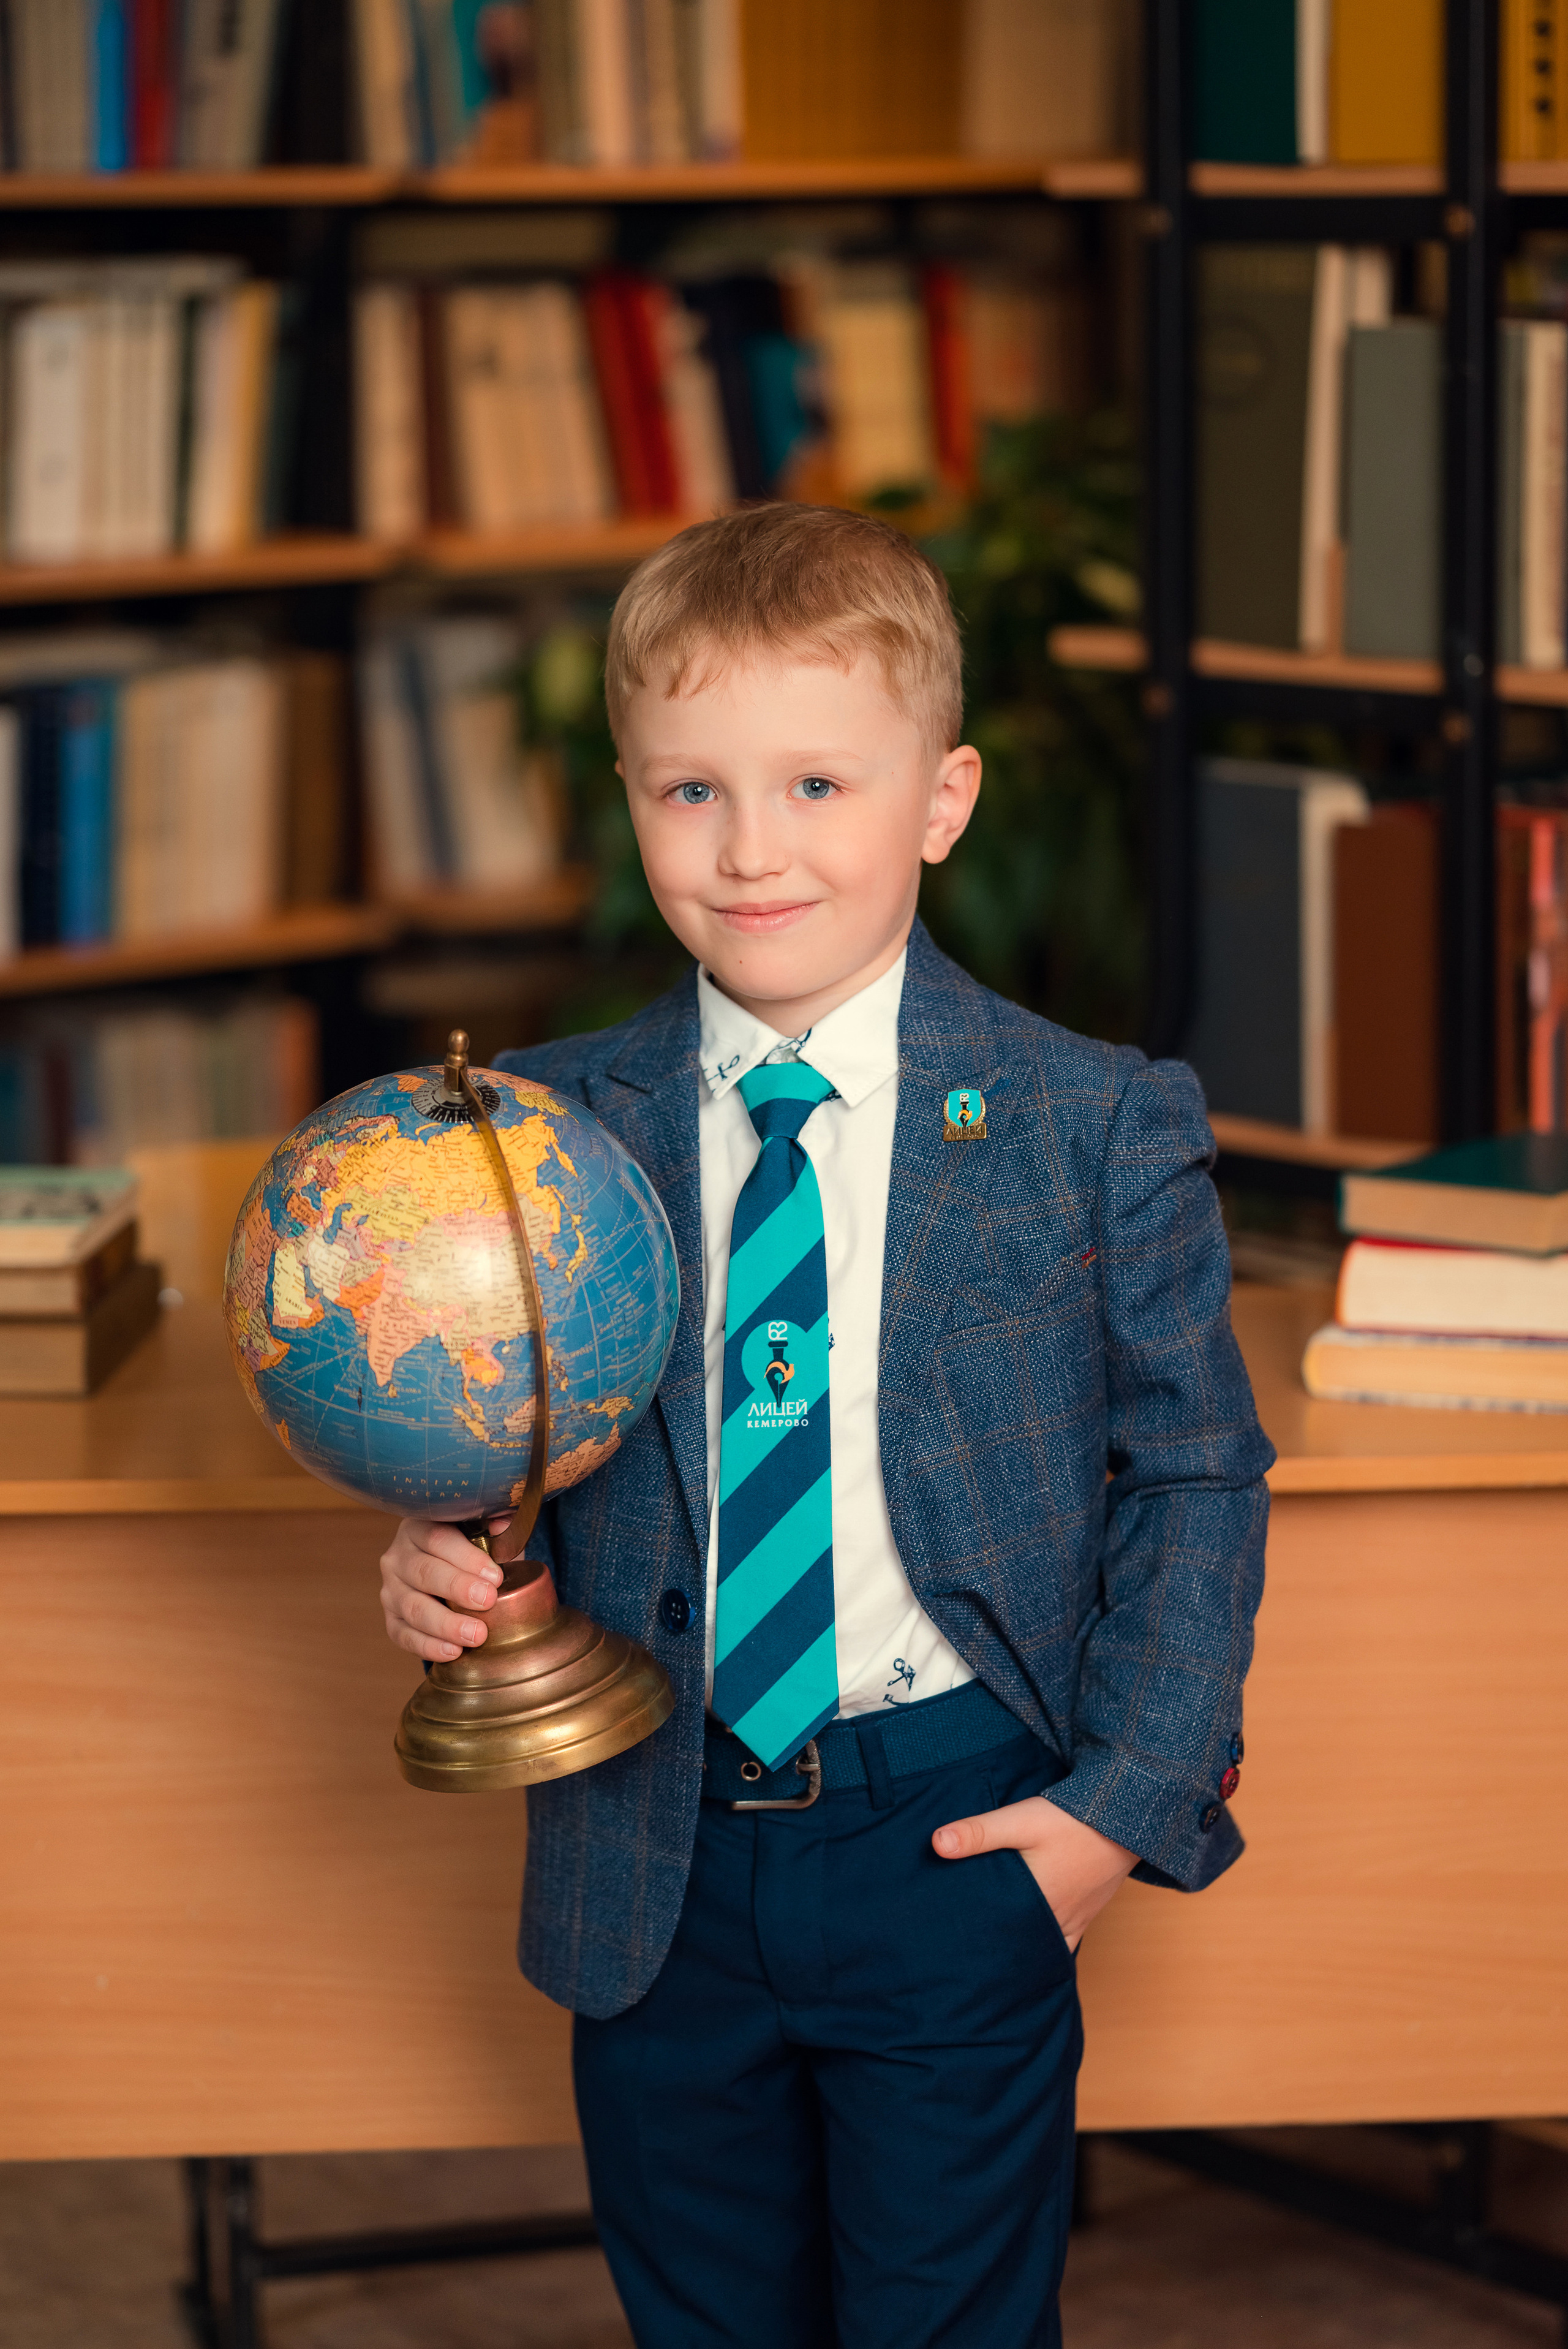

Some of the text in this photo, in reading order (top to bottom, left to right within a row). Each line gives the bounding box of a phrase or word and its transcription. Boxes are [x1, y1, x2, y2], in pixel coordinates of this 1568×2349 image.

[768, 1322, 788, 1341] 62
[748, 1399, 808, 1417] ЛИЦЕЙ
[747, 1418, 809, 1429] КЕМЕРОВО
[393, 1475, 469, 1486] INDIAN
[396, 1488, 461, 1498] OCEAN
